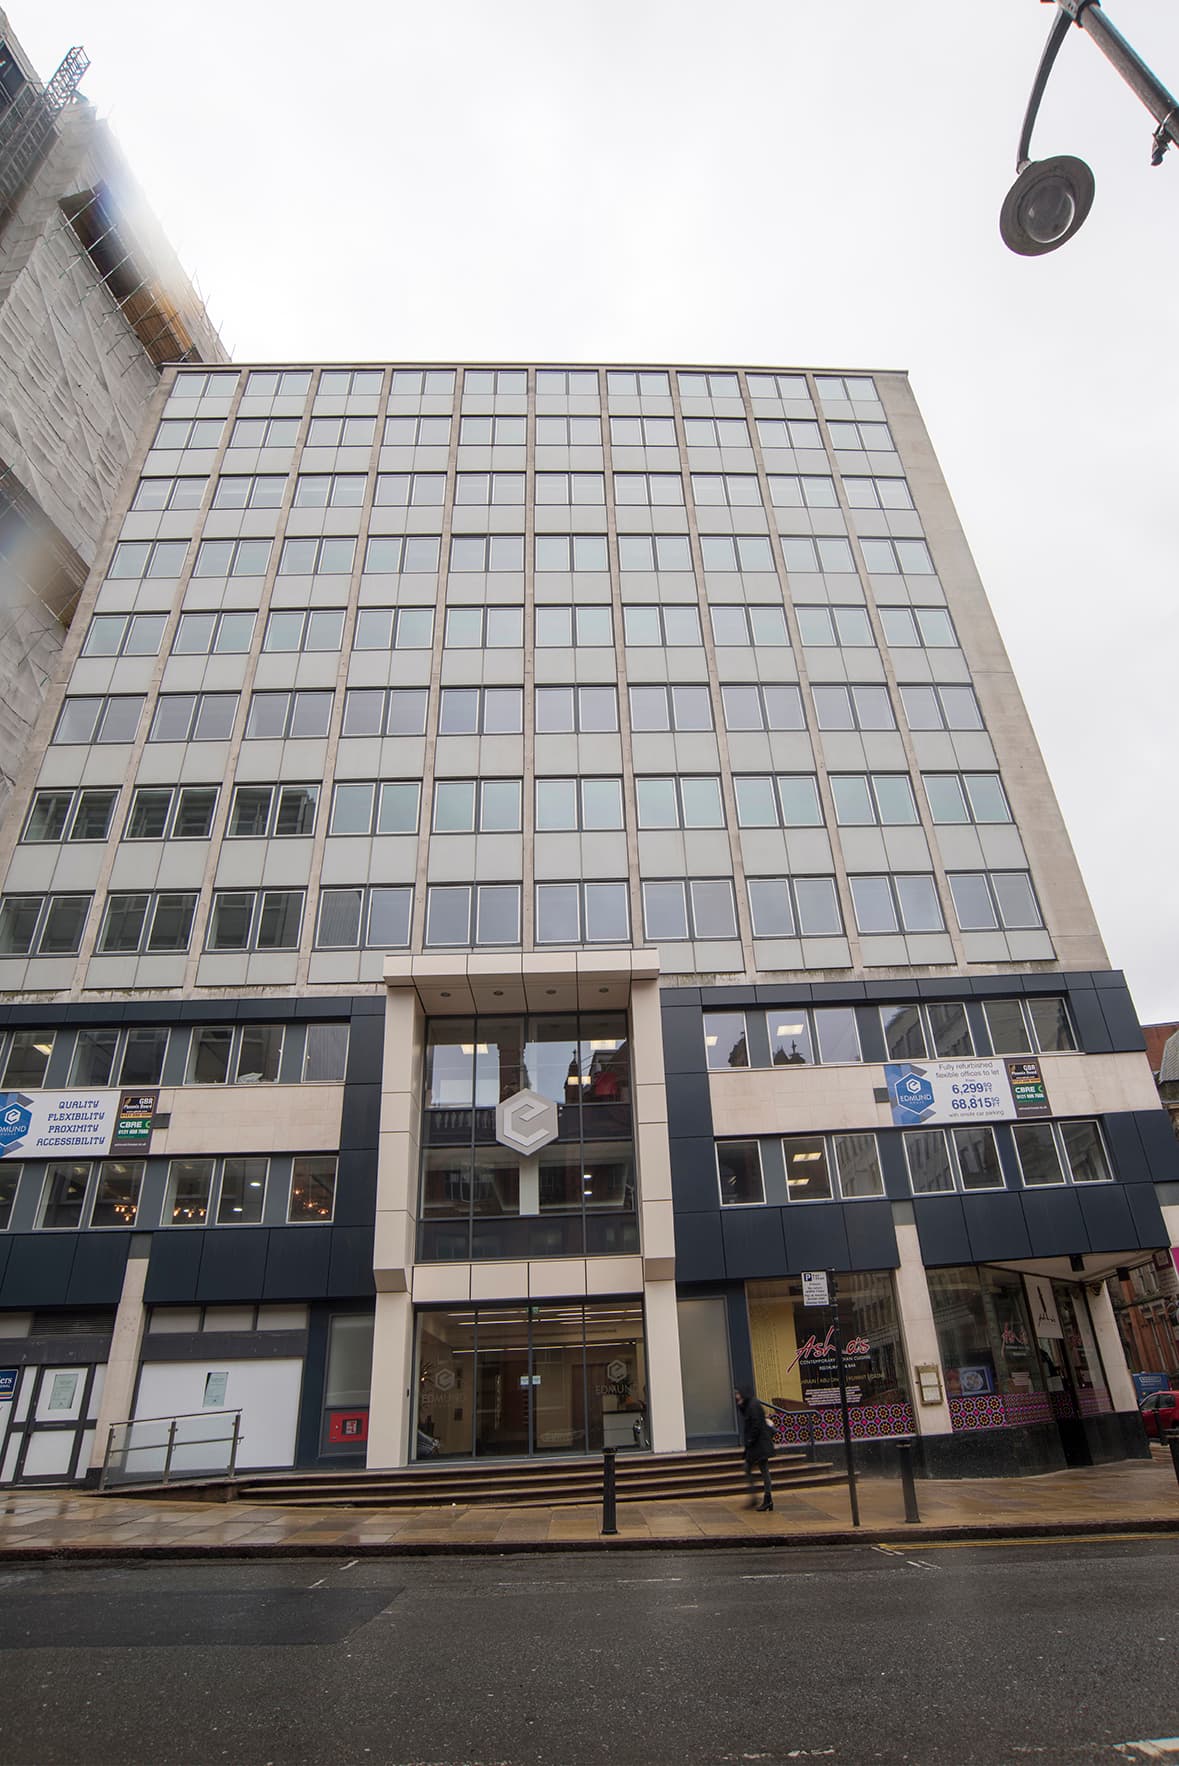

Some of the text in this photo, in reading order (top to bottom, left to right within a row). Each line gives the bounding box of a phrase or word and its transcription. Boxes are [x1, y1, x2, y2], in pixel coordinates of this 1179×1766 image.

[900, 1094, 932, 1102] EDMUND
[58, 1101, 100, 1109] QUALITY
[951, 1097, 992, 1110] 68,815
[47, 1112, 105, 1121] FLEXIBILITY
[48, 1124, 99, 1133] PROXIMITY
[36, 1137, 106, 1146] ACCESSIBILITY
